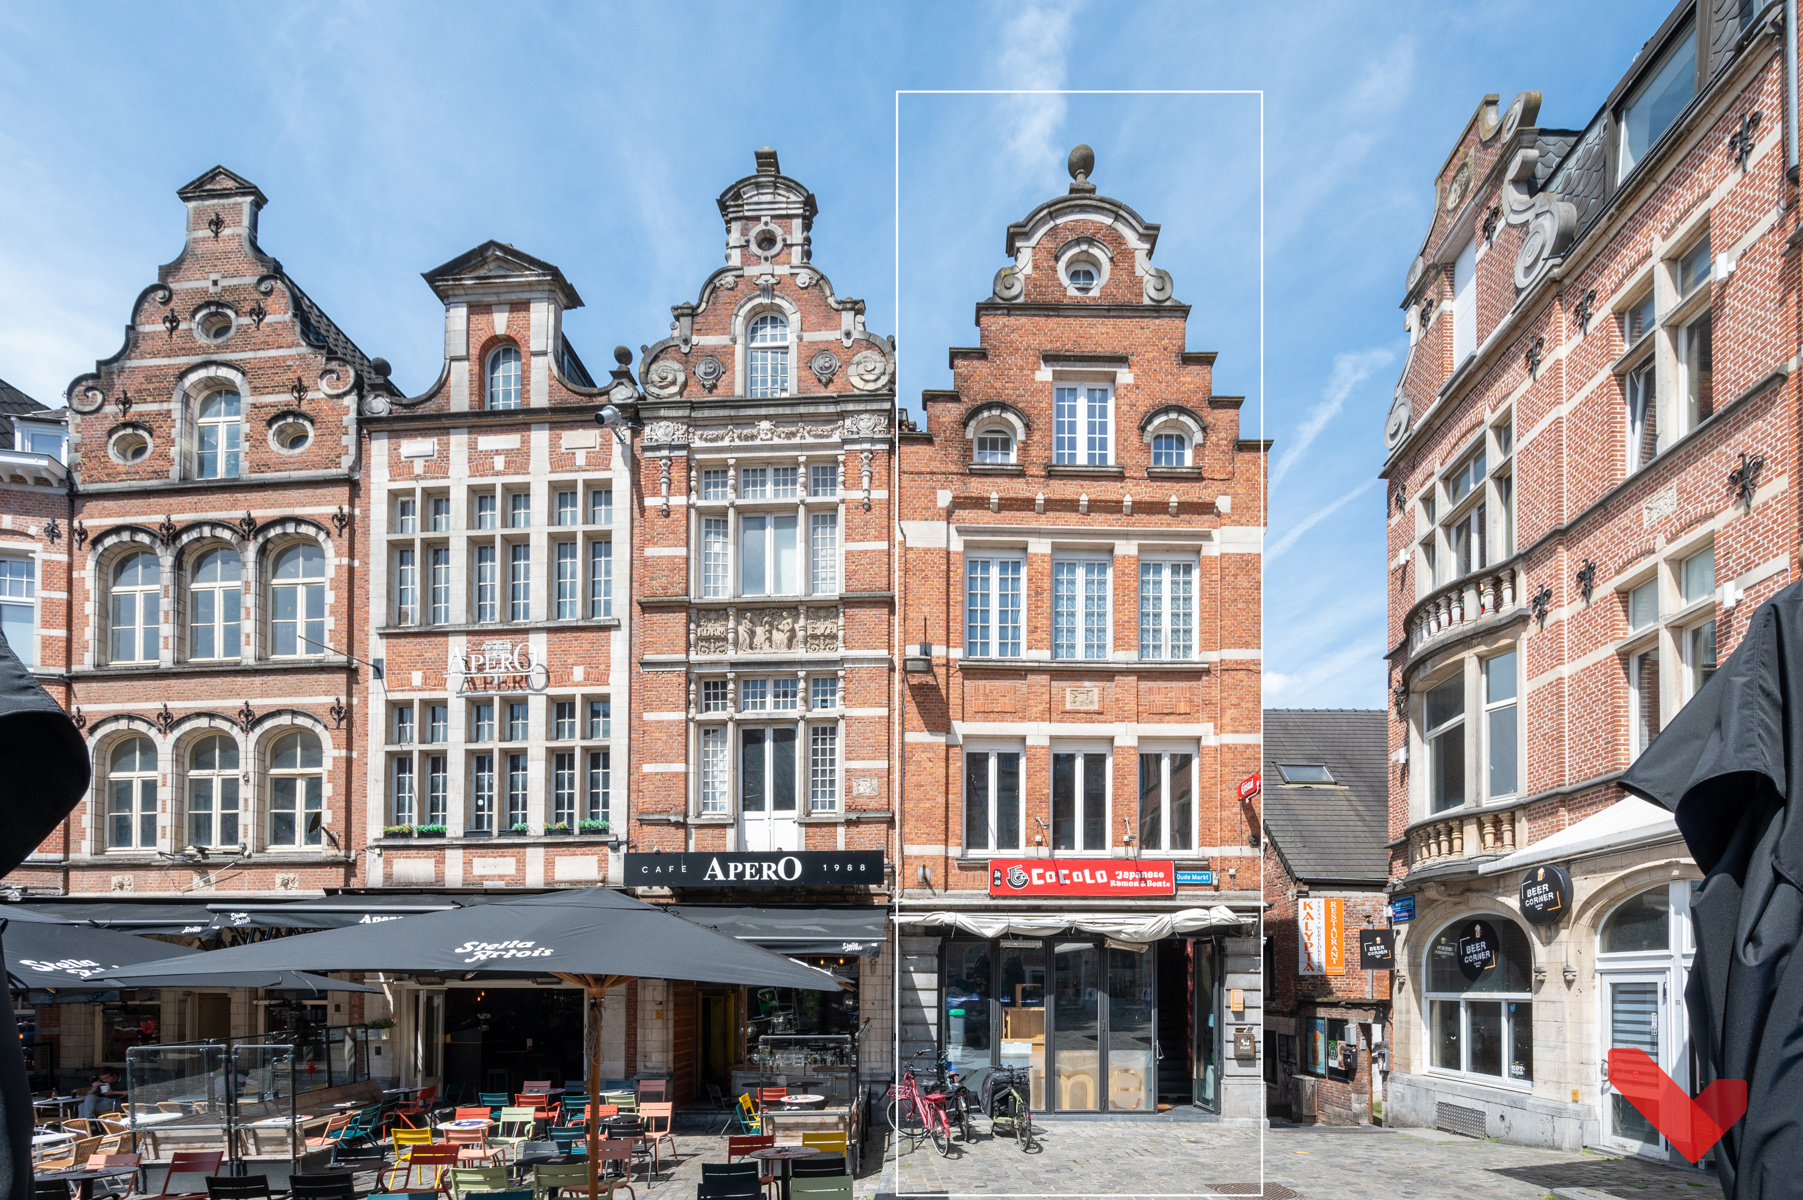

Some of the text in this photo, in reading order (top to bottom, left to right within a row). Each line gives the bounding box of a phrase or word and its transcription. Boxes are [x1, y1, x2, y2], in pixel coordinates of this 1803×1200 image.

[697, 627, 727, 637] ADAM
[810, 626, 836, 636] EVA
[823, 863, 866, 872] 1988
[1114, 870, 1165, 881] Japanese
[1526, 883, 1549, 898] BEER
[1525, 892, 1554, 907] CORNER
[1303, 901, 1315, 972] KALYPTA
[1330, 901, 1339, 965] RESTAURANT
[455, 940, 536, 953] Stella
[1466, 941, 1487, 954] BEER
[464, 948, 554, 962] Artois
[1464, 950, 1491, 964] CORNER
[19, 959, 100, 972] Stella
